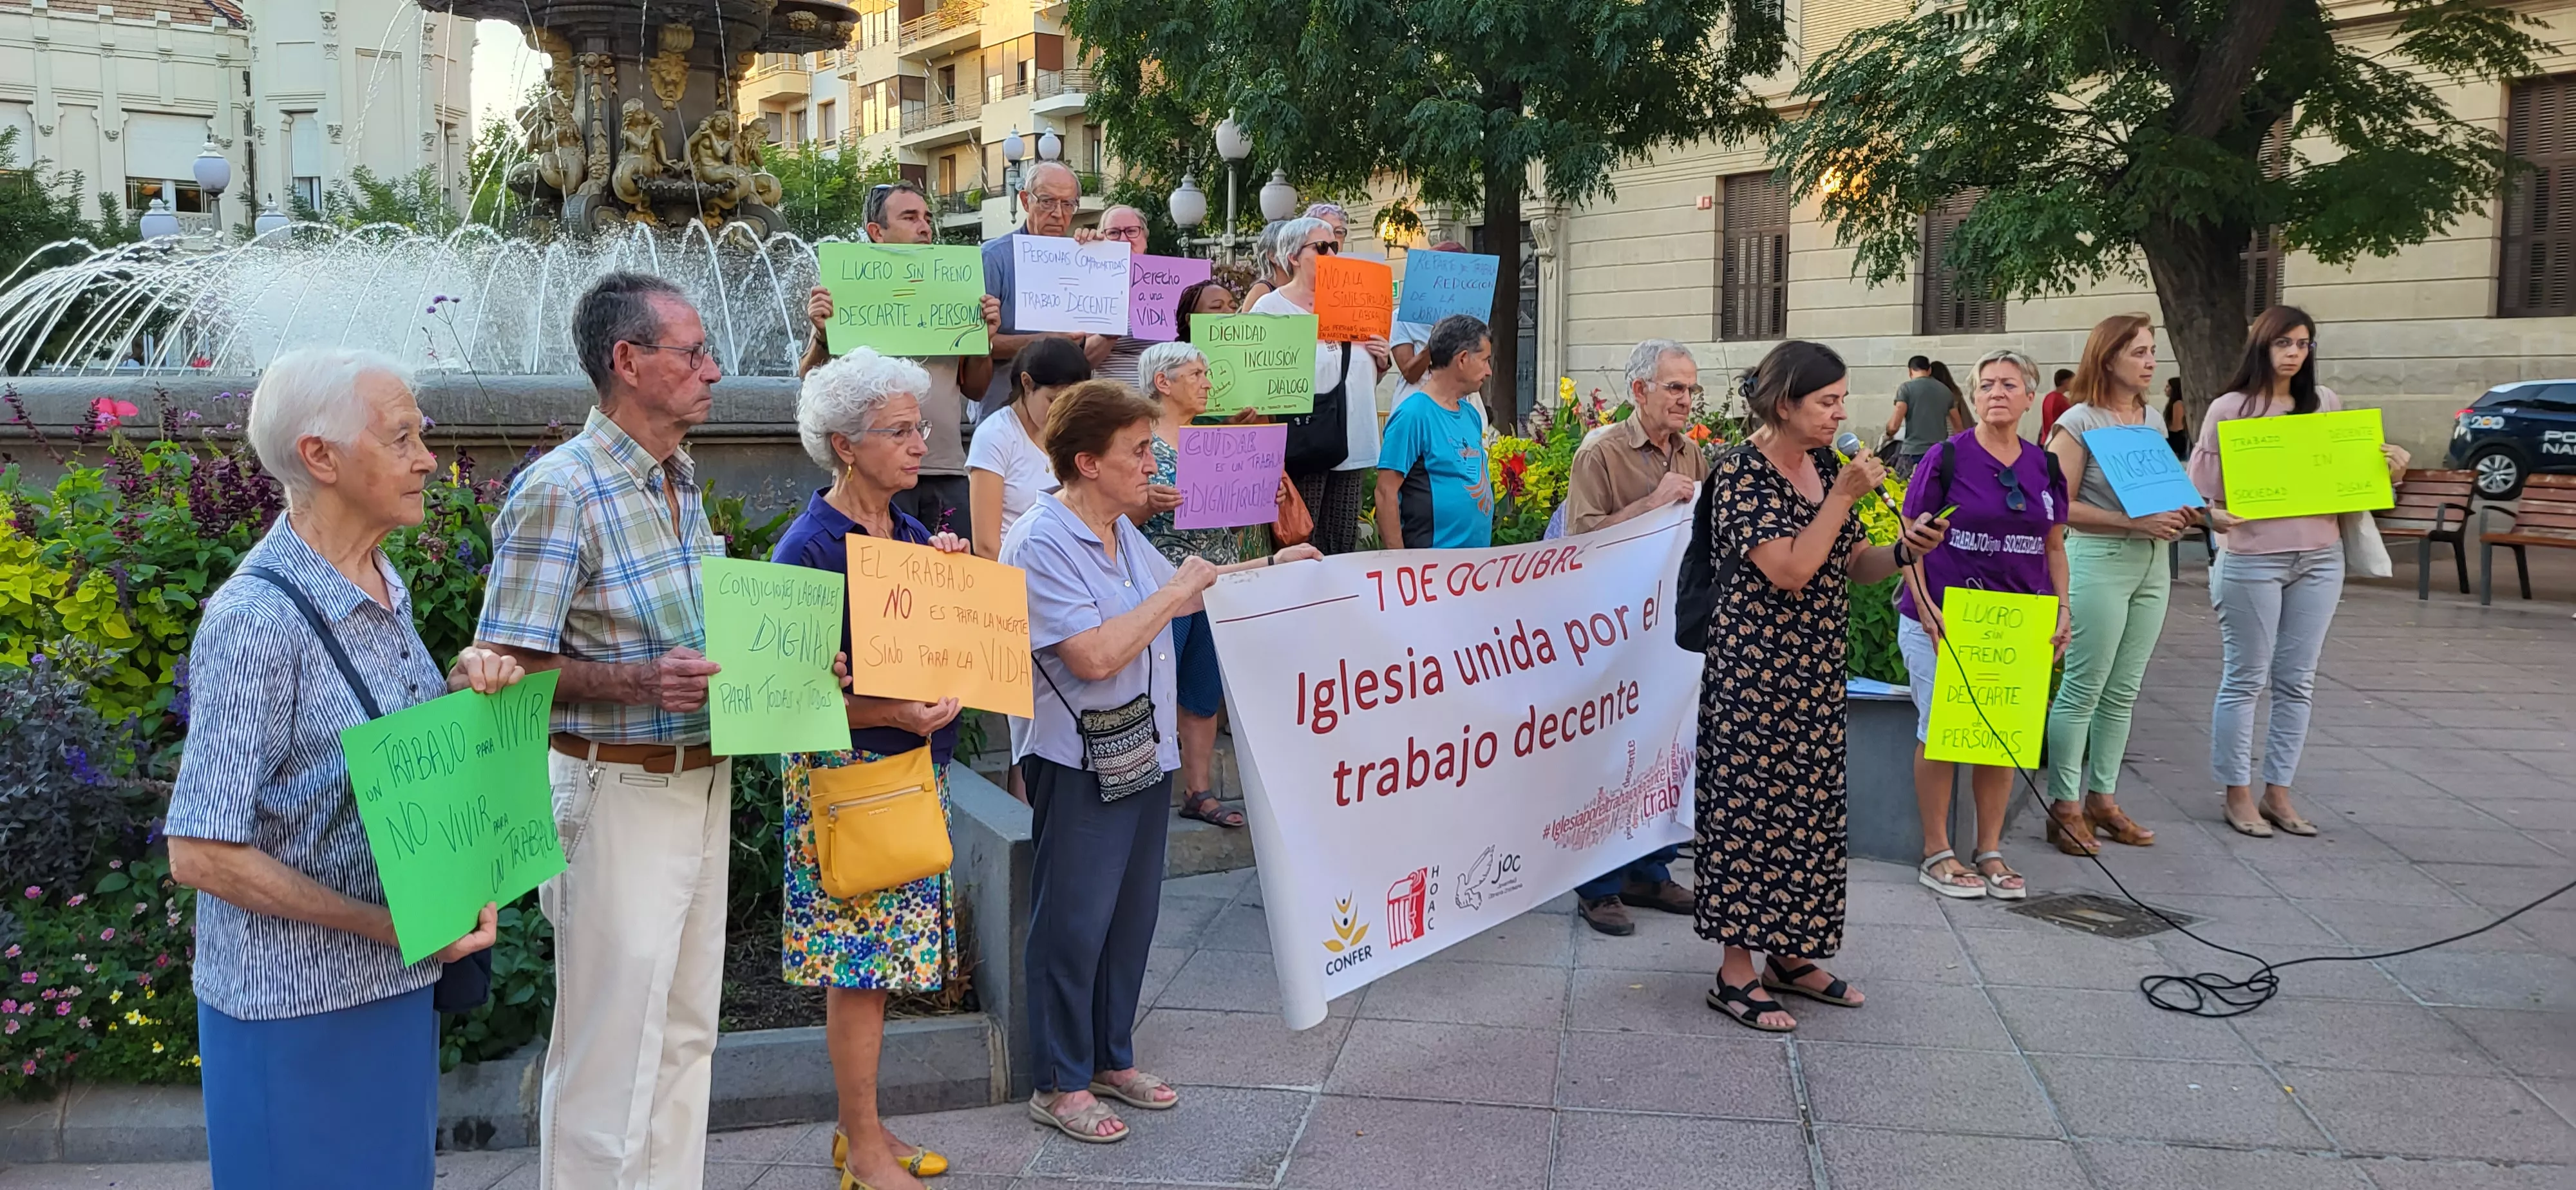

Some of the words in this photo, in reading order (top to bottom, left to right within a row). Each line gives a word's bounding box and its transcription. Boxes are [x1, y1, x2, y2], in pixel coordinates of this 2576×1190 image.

[1022, 241, 1070, 265] PERSONAS
[842, 260, 893, 280] LUCRO
[934, 259, 972, 282] FRENO
[1132, 262, 1180, 288] Derecho
[1343, 270, 1350, 288] A
[1352, 270, 1363, 287] LA
[1021, 292, 1061, 309] TRABAJO
[1410, 292, 1427, 301] DE
[1439, 294, 1455, 303] LA
[839, 303, 911, 326] DESCARTE
[1209, 322, 1266, 341] DIGNIDAD
[1186, 428, 1256, 458] CUIDAR
[2543, 442, 2576, 455] NA
[2544, 430, 2576, 442] PO
[1232, 462, 1243, 471] UN
[2233, 487, 2287, 499] SOCIEDAD
[861, 545, 887, 579] EL
[900, 552, 974, 592] TRABAJO
[1366, 571, 1385, 612] 7
[1397, 563, 1439, 607] DE
[1447, 540, 1594, 597] OCTUBRE
[798, 580, 840, 614] LABORALES
[883, 583, 912, 620] NO
[930, 605, 945, 620] ES
[953, 606, 978, 625] PARA
[984, 612, 994, 628] LA
[996, 614, 1028, 636] MUERTE
[1963, 603, 2023, 627] LUCRO
[748, 613, 835, 670] DIGNAS
[1958, 645, 2016, 664] FRENO
[864, 635, 902, 667] SINO
[918, 645, 949, 668] PARA
[956, 652, 972, 670] LA
[980, 638, 1030, 687] VIDA
[1296, 647, 1444, 735] Iglesia
[1454, 619, 1557, 686] unida
[1564, 605, 1629, 666] por
[1643, 580, 1663, 631] el
[719, 683, 753, 714] PARA
[1947, 685, 2022, 706] DESCARTE
[490, 684, 544, 751] VIVIR
[372, 721, 466, 788] TRABAJO
[475, 737, 495, 758] PARA
[1334, 725, 1497, 807] trabajo
[1514, 679, 1640, 758] decente
[1942, 728, 2022, 758] PERSONAS
[366, 778, 382, 802] UN
[1643, 776, 1680, 818] trab
[386, 802, 428, 860] NO
[438, 795, 491, 853] VIVIR
[493, 813, 509, 836] PARA
[491, 853, 504, 894] UN
[502, 817, 558, 869] TRABAJO
[1325, 945, 1373, 976] CONFER
